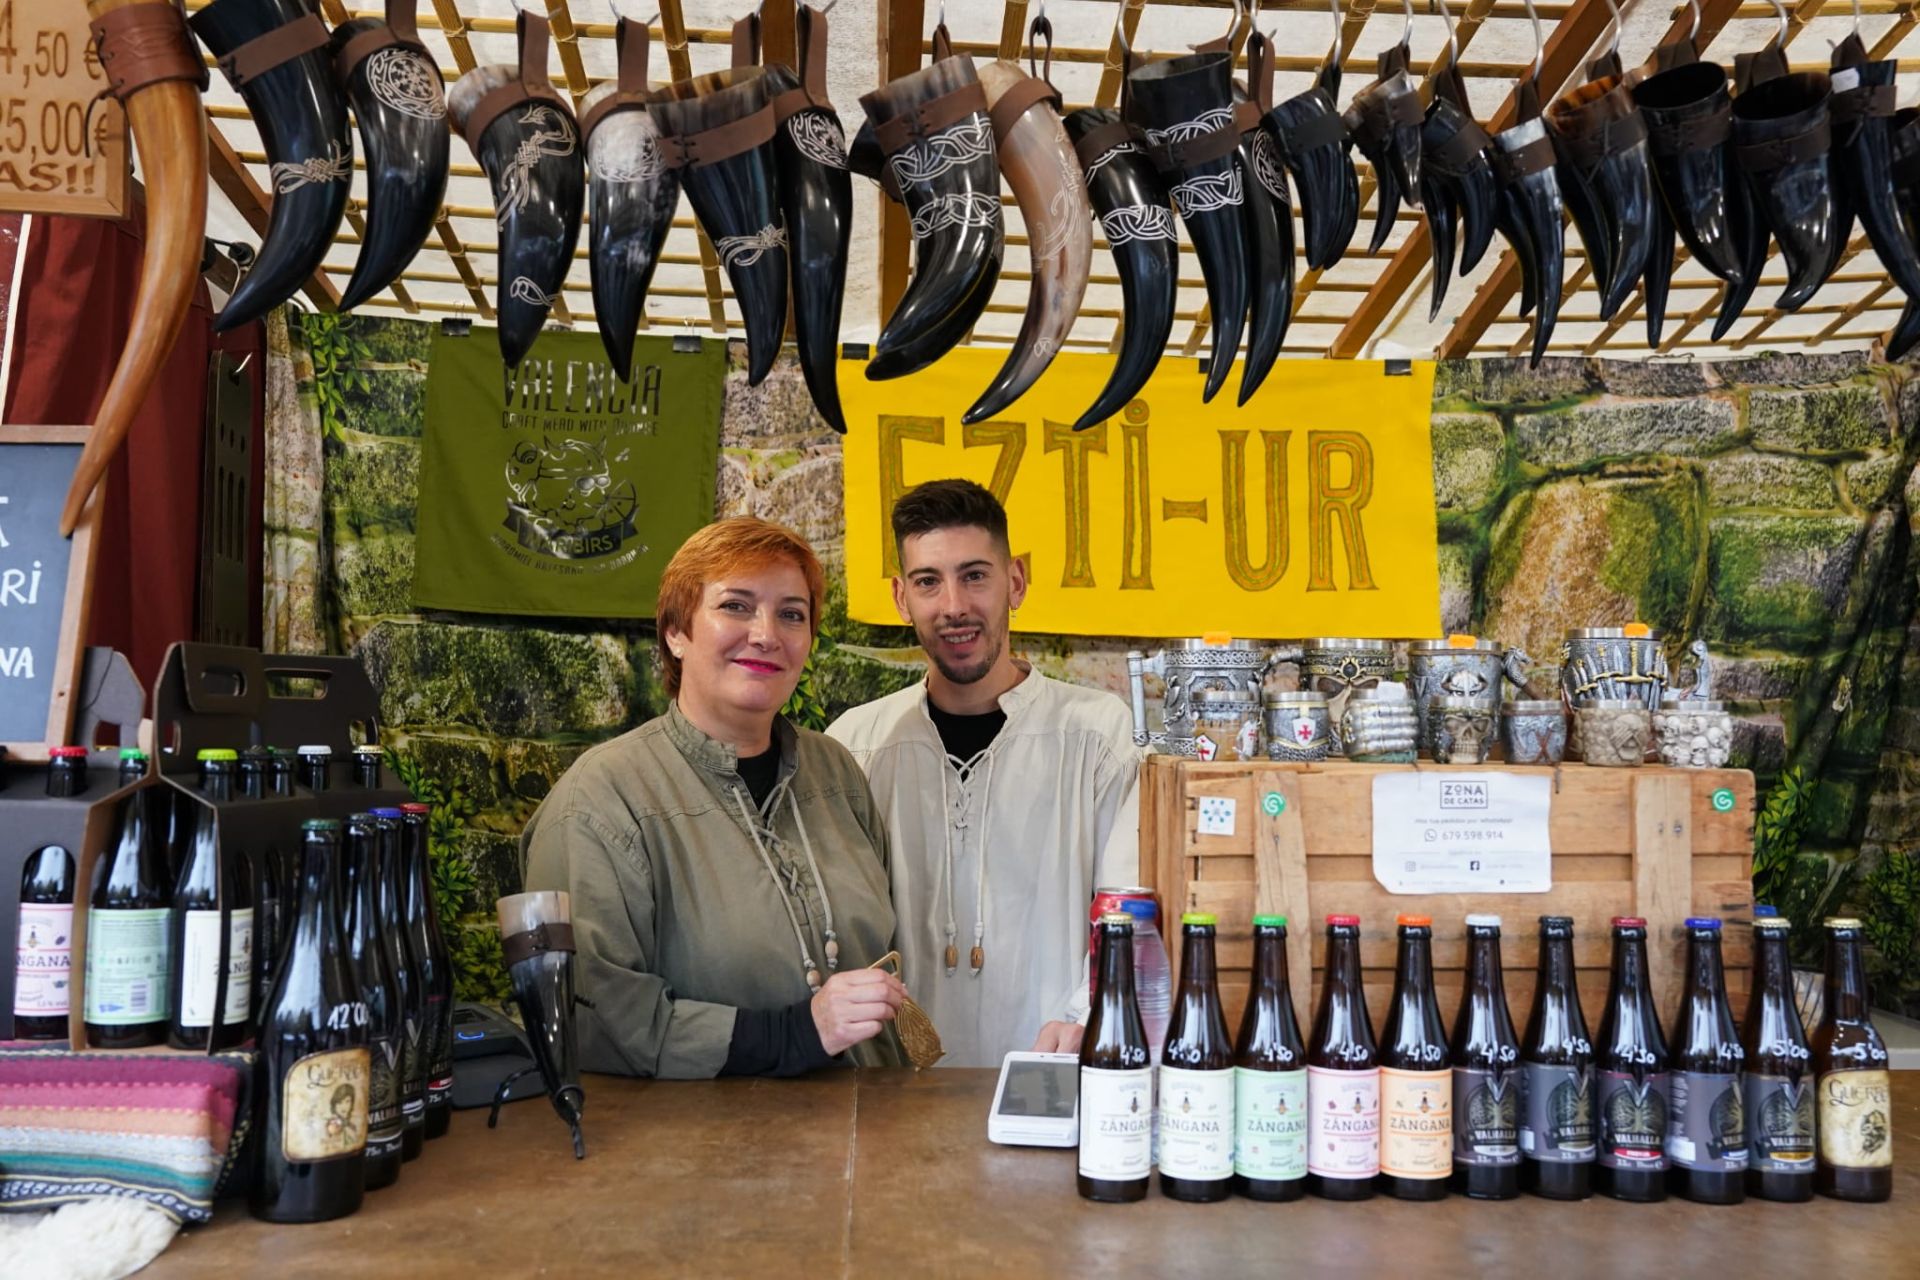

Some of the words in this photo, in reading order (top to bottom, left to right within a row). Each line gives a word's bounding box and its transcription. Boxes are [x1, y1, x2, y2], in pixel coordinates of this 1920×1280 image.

[502, 358, 662, 416] VALENCIA
[543, 418, 575, 433] MEAD
[1444, 784, 1485, 796] ZONA
[1444, 797, 1455, 805] DE
[1457, 797, 1485, 805] CATAS
[1614, 1132, 1660, 1146] VALHALLA
